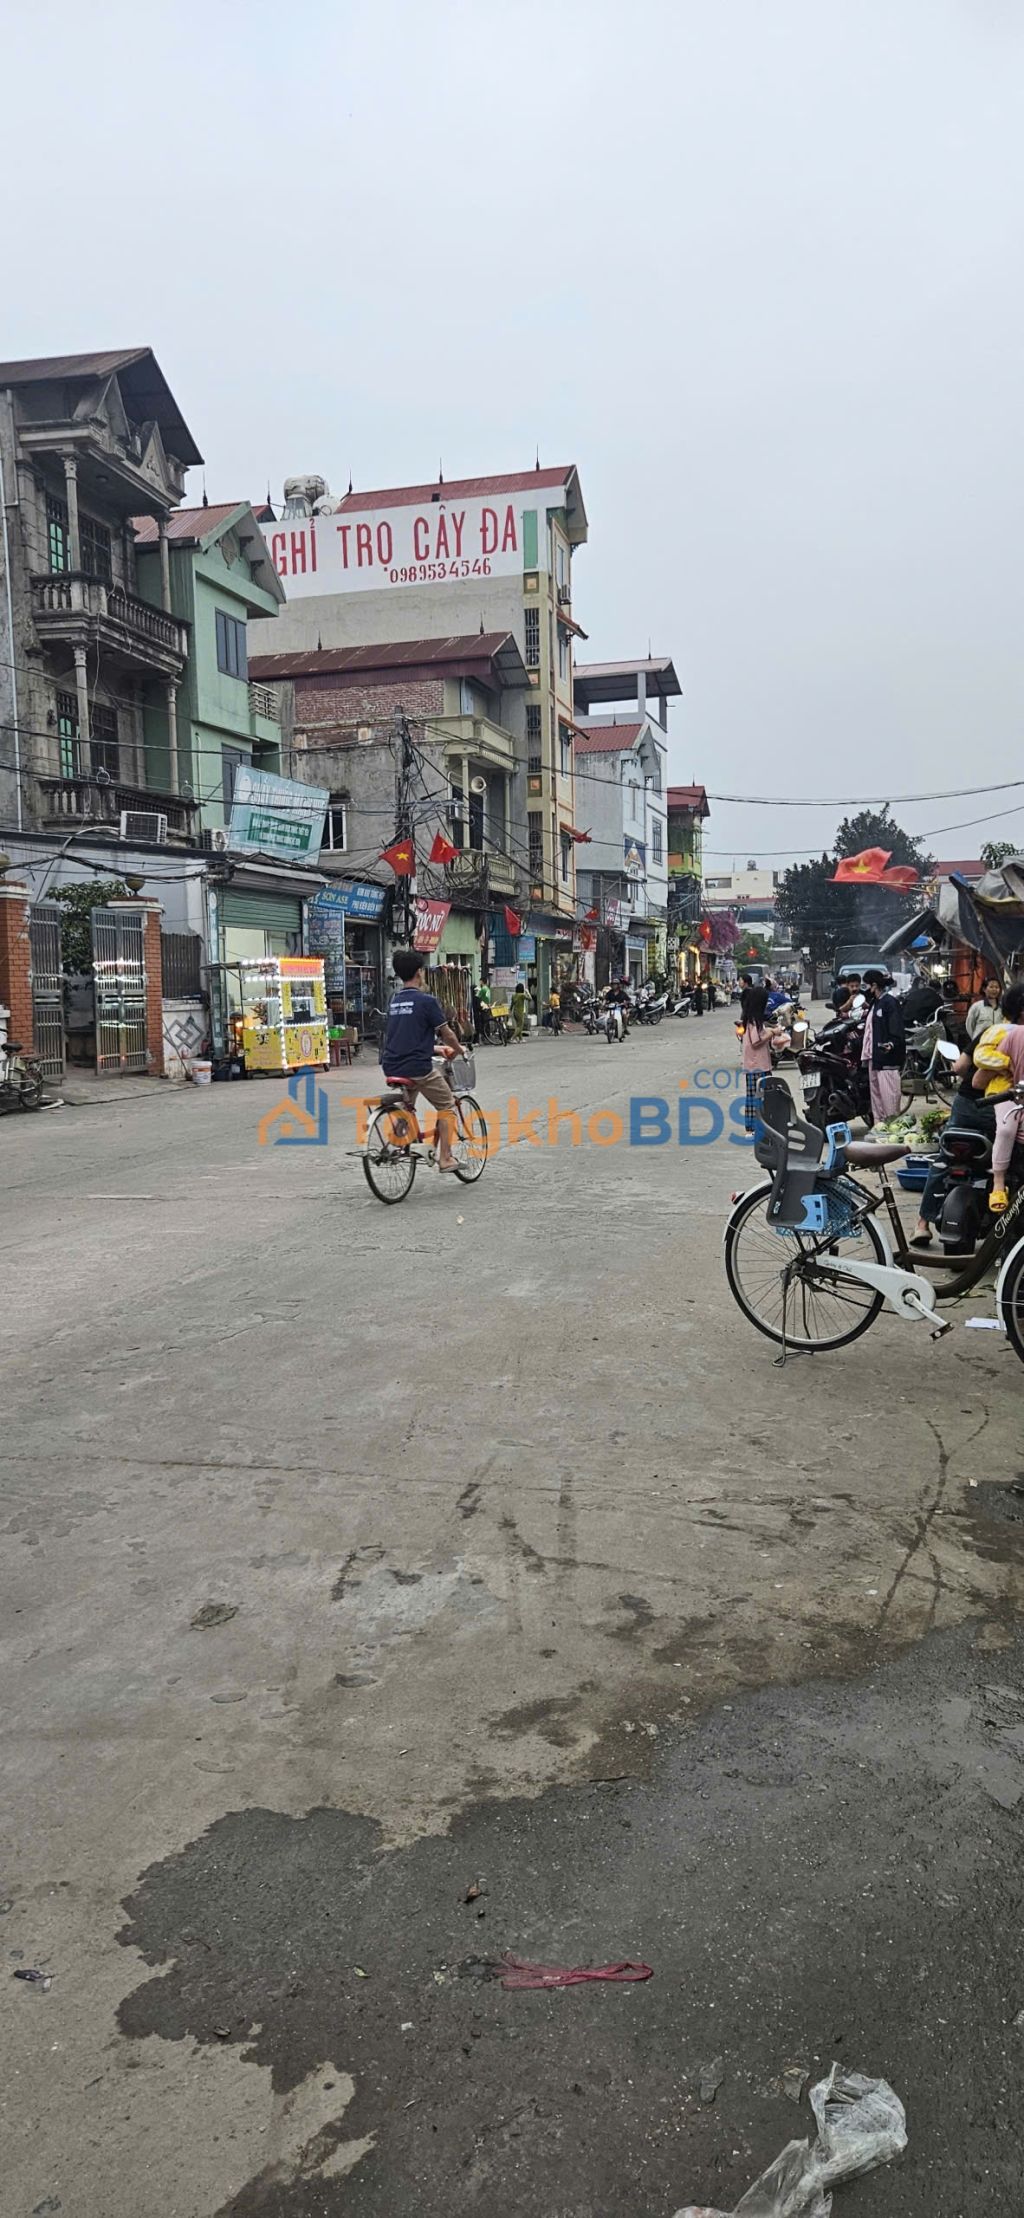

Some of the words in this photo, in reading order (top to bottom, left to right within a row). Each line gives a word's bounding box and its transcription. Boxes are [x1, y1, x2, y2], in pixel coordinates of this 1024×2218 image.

[264, 517, 318, 577] GHỈ
[336, 520, 393, 573] TRỌ
[413, 504, 466, 561] CÂY
[480, 504, 518, 555] ĐA
[389, 556, 492, 584] 0989534546
